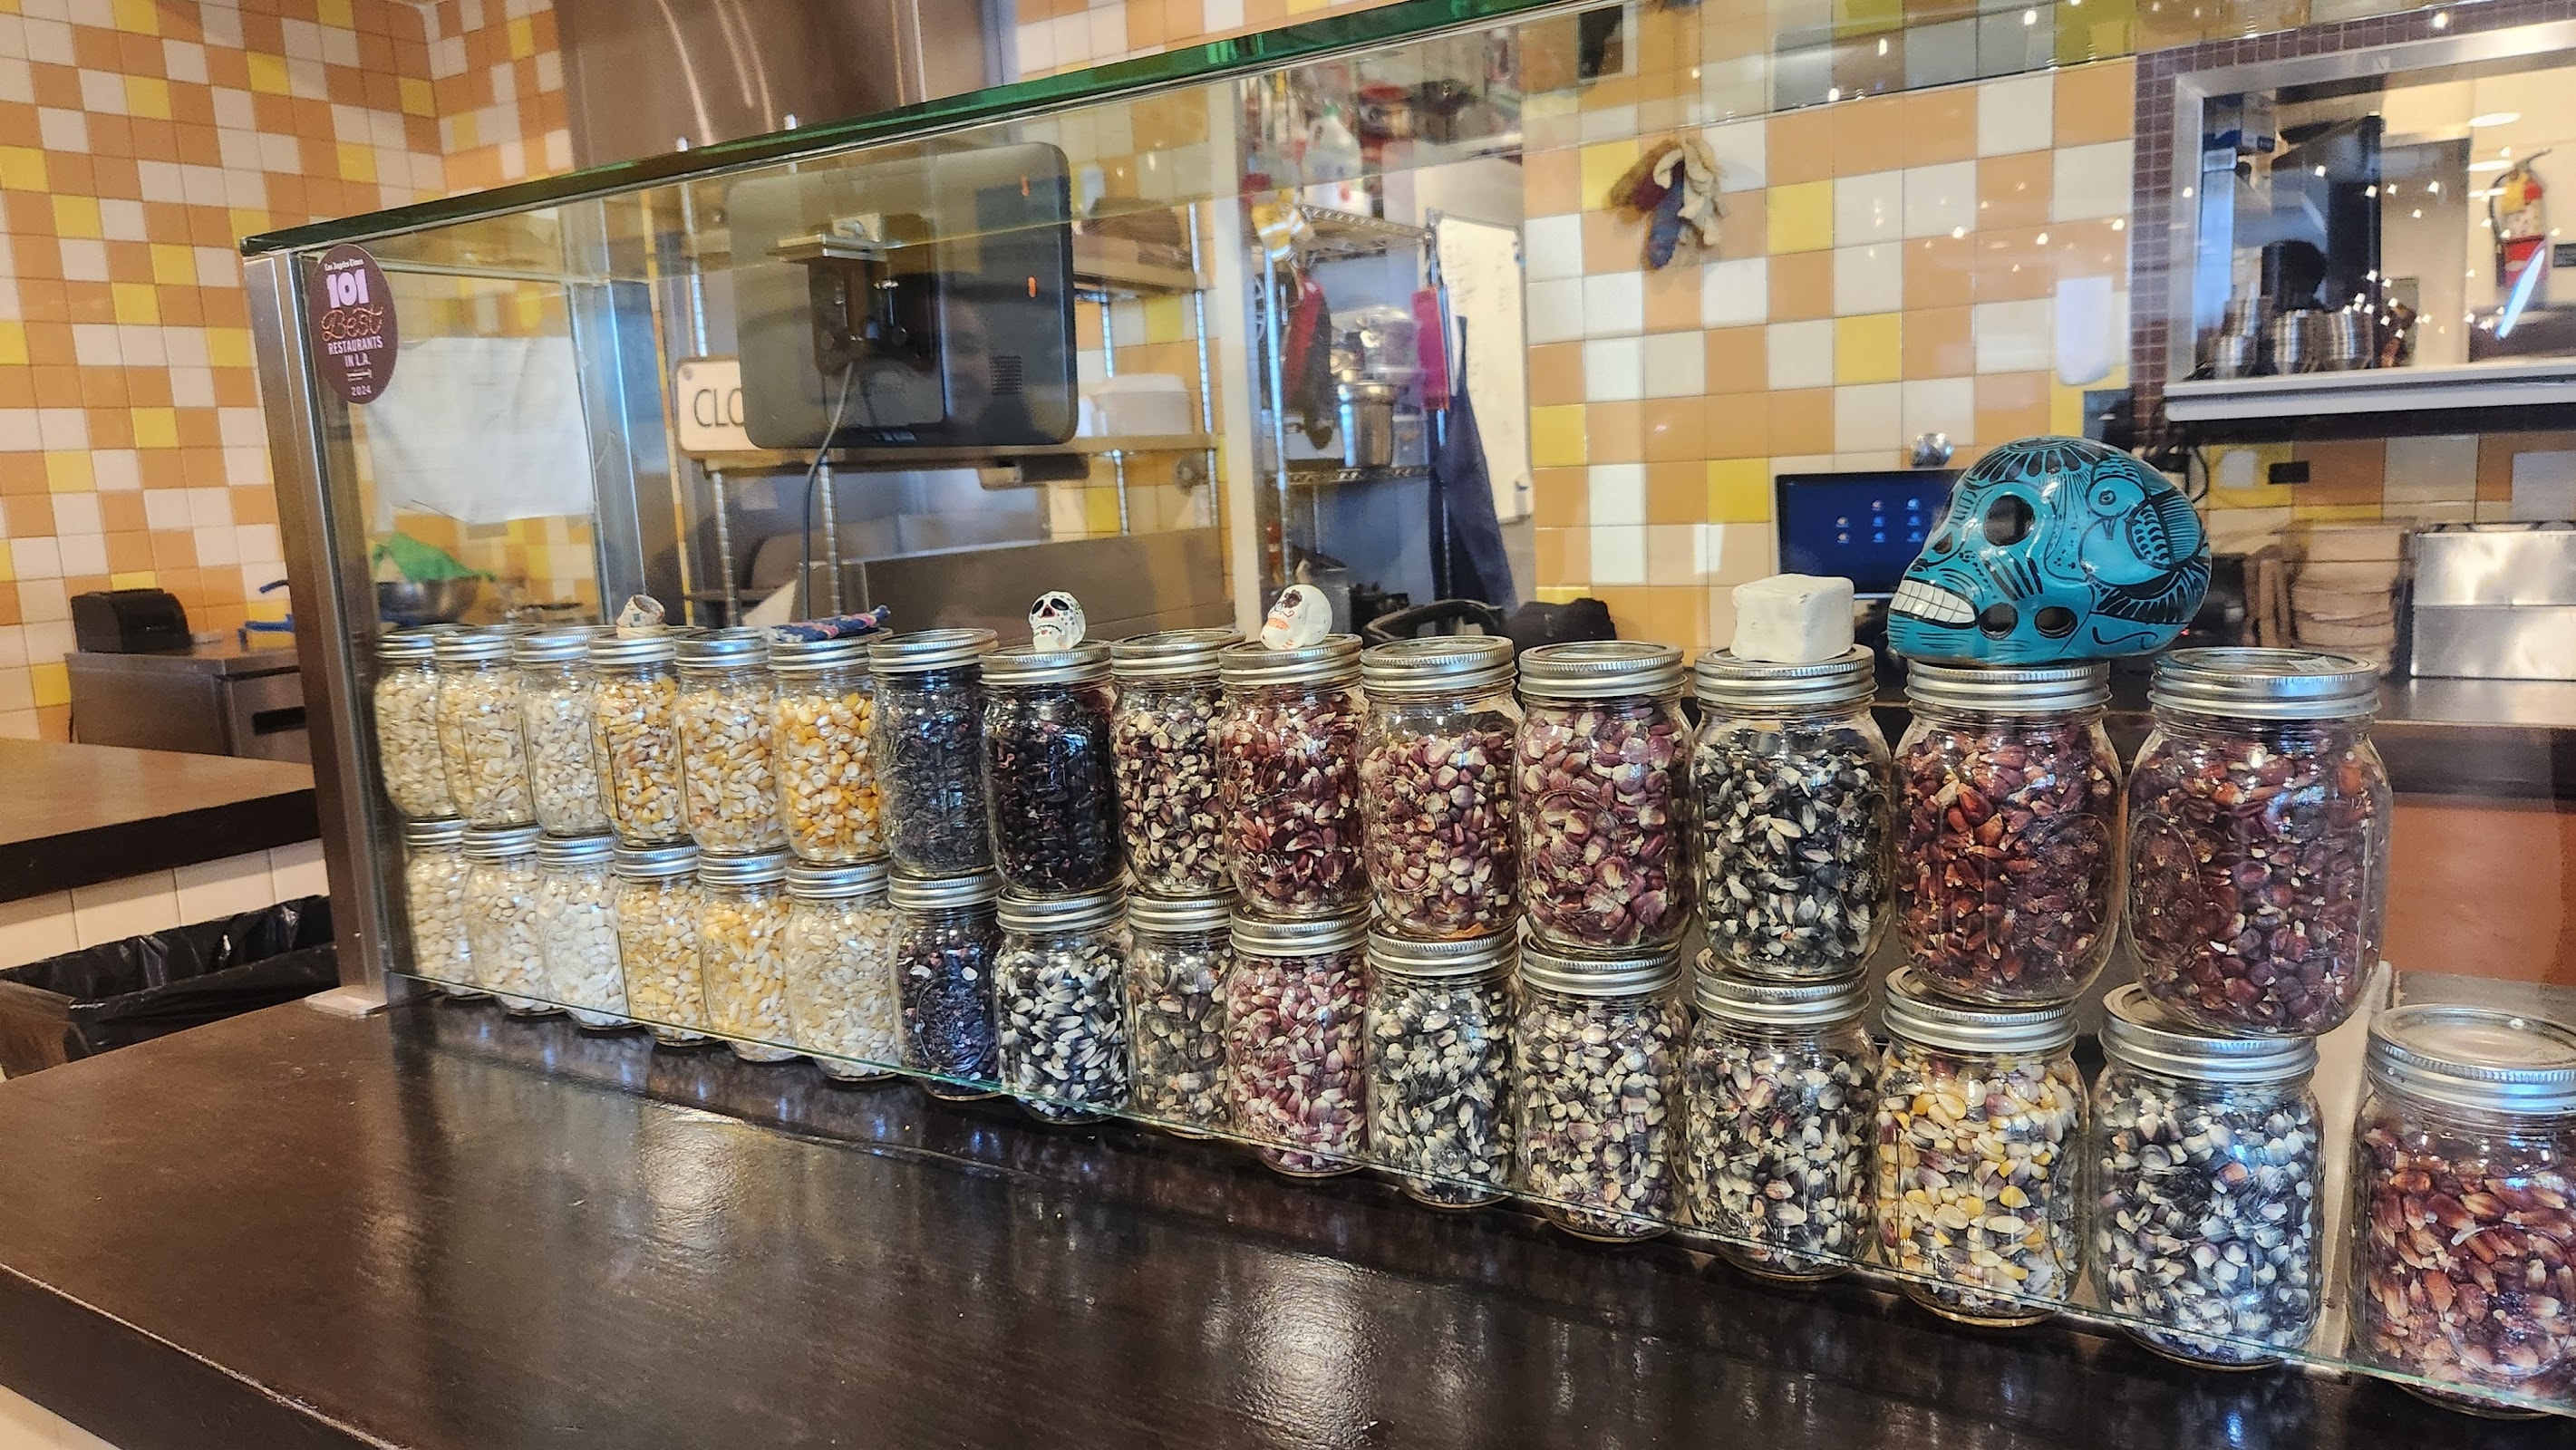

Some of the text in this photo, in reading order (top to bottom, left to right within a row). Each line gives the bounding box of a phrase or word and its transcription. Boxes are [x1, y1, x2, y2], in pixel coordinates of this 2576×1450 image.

[333, 261, 350, 270] Angeles
[349, 258, 364, 267] Times
[326, 268, 370, 309] 101
[322, 304, 383, 342] Best
[328, 335, 383, 355] RESTAURANTS
[344, 354, 354, 368] IN
[351, 385, 372, 396] 2024
